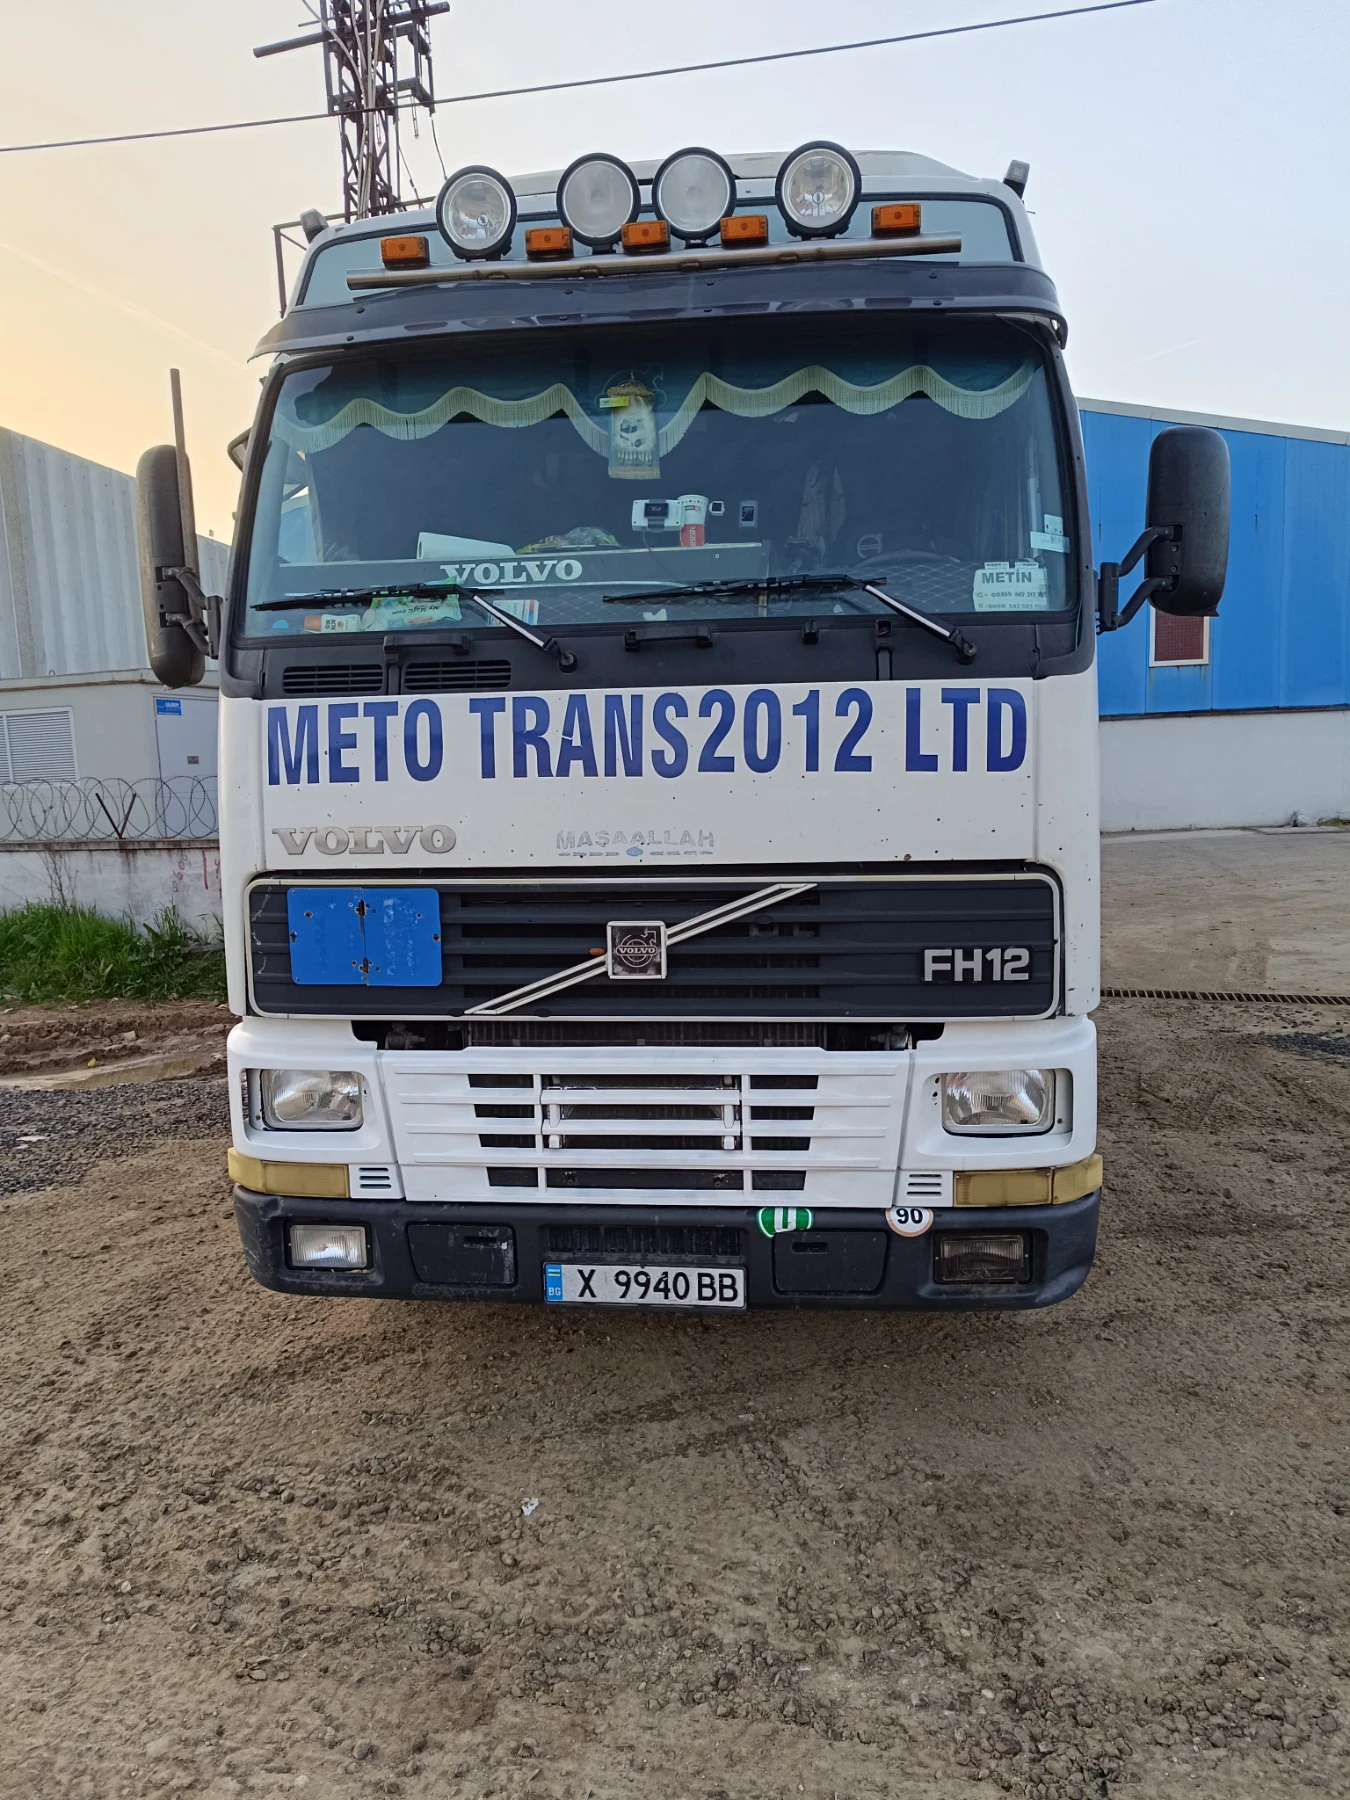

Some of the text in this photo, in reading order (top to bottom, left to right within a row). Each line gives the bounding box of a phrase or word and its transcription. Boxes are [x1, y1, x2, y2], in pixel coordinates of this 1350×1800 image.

[440, 559, 583, 584] VOLVO
[267, 698, 444, 786] METO
[905, 687, 1028, 773] LTD
[272, 824, 457, 855] VOLVO
[924, 948, 1030, 982] FH12
[896, 1208, 924, 1225] 90
[548, 1286, 562, 1296] BG
[577, 1269, 739, 1302] X 9940 BB
